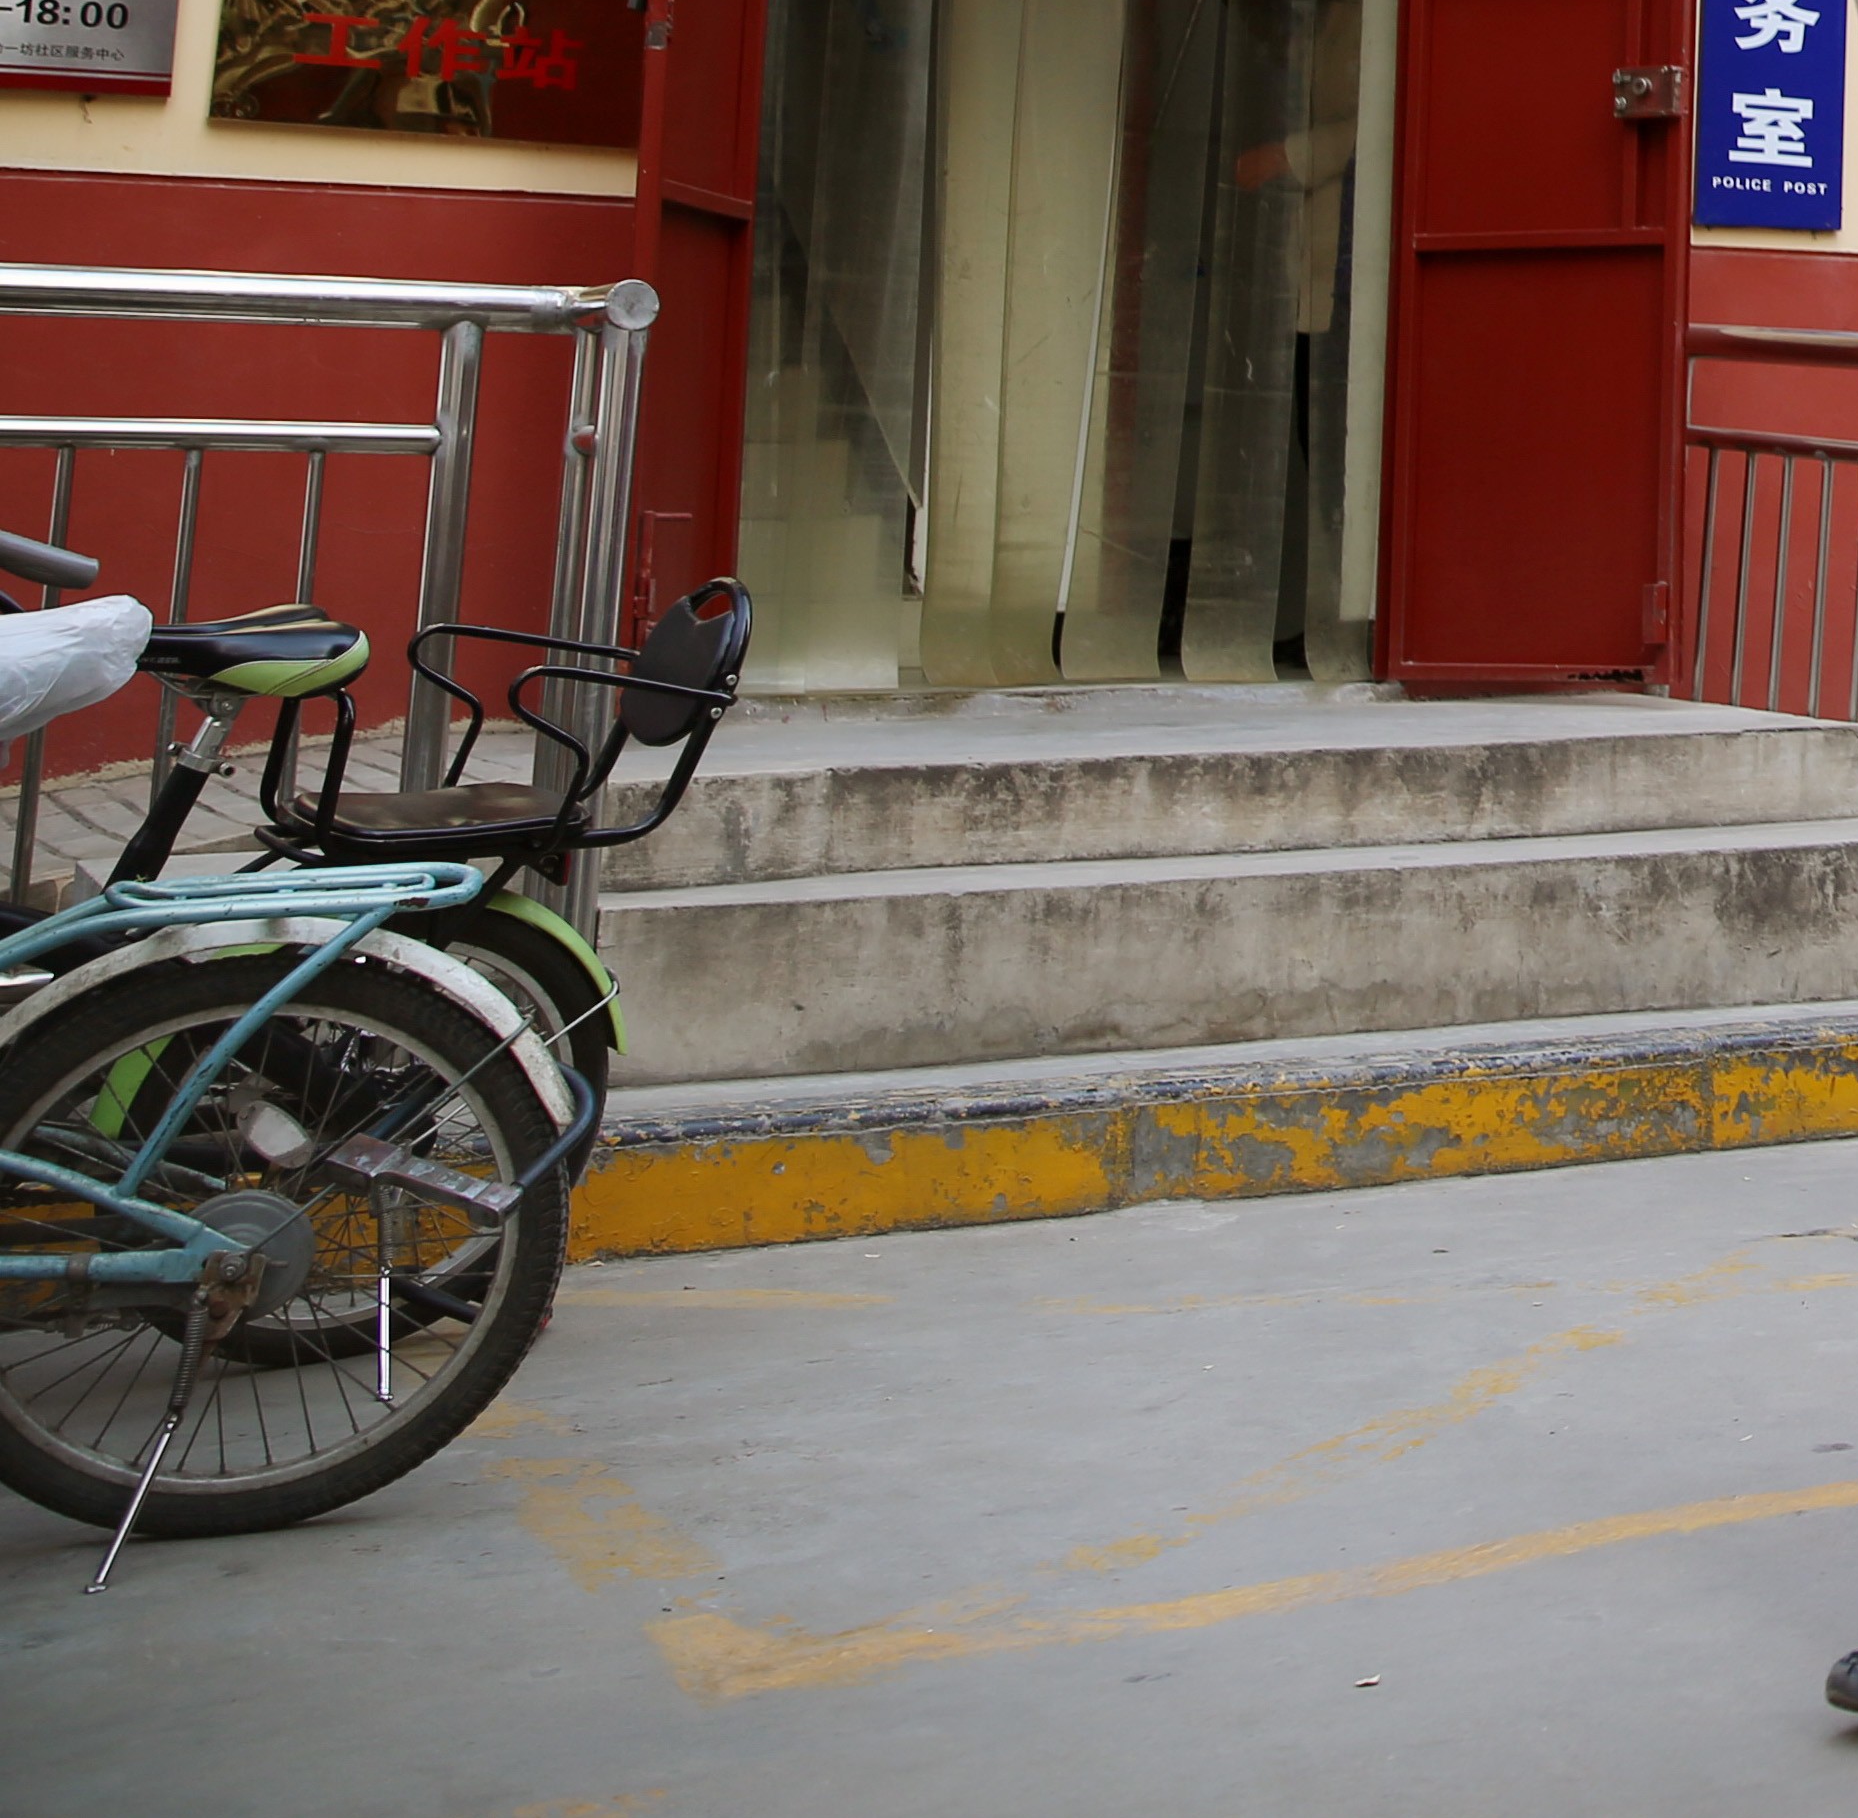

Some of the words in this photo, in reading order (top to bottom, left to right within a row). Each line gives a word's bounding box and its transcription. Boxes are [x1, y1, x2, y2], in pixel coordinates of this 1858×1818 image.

[0, 42, 126, 62] 一坊社区服务中心
[291, 11, 585, 90] 工作站
[1711, 175, 1773, 193] POLICE
[1782, 179, 1829, 197] POST
